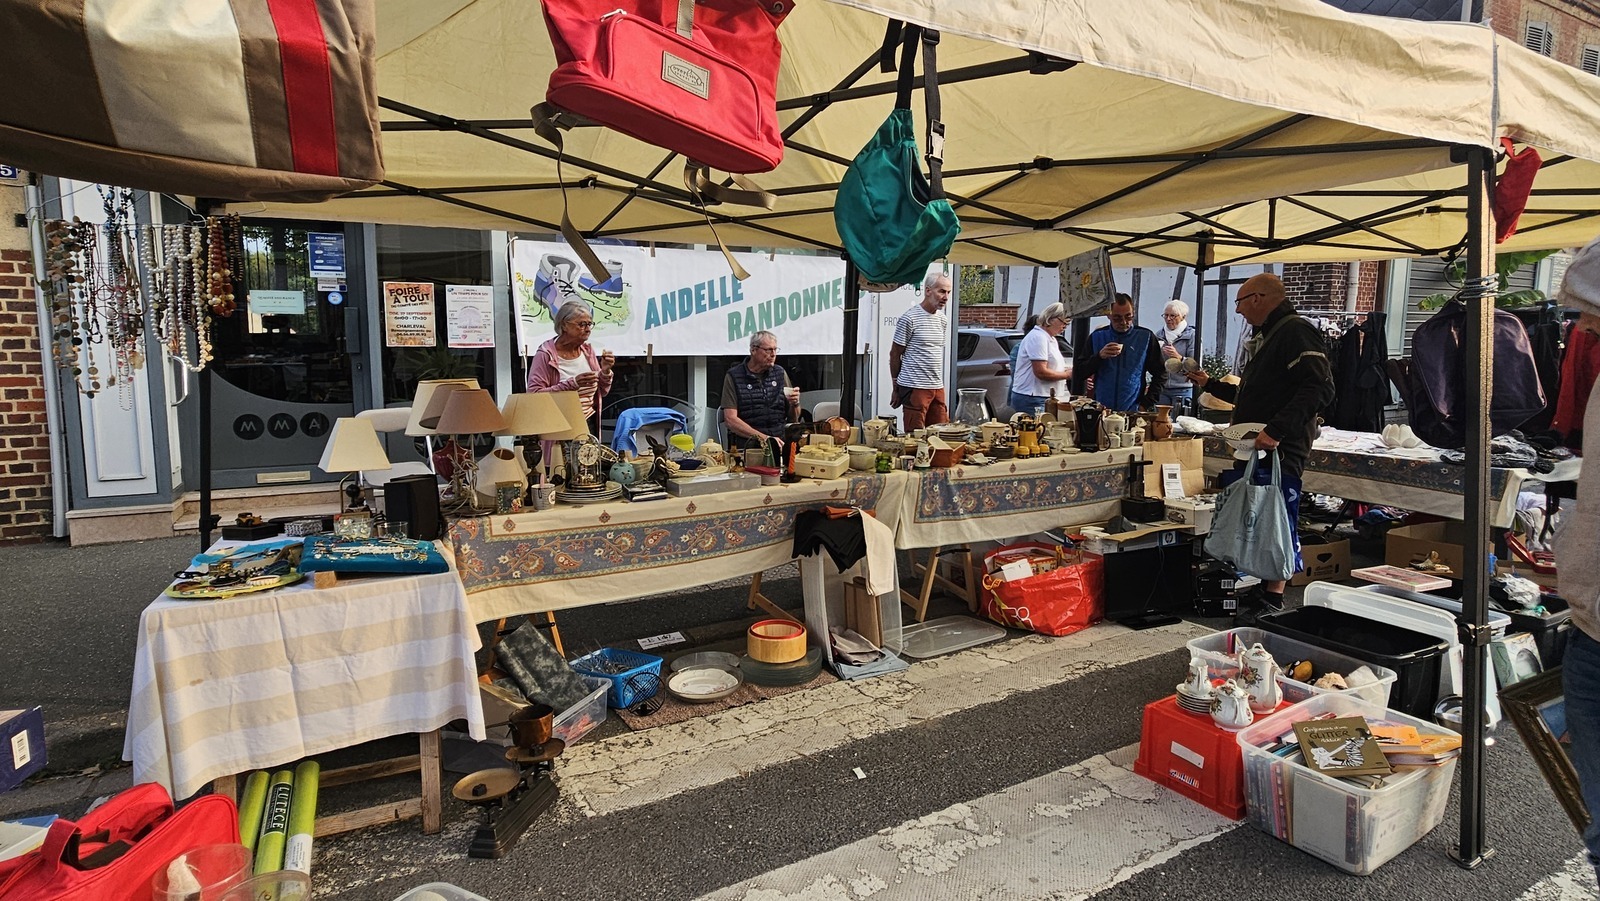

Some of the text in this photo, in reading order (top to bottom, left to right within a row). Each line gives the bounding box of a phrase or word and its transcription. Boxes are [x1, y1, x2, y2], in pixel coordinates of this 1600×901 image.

[389, 286, 421, 296] FOIRE
[403, 293, 430, 303] TOUT
[645, 274, 744, 331] ANDELLE
[728, 276, 866, 342] RANDONNE
[240, 418, 321, 432] MMA
[1309, 730, 1351, 740] GLITTER
[272, 786, 290, 829] LUTECE
